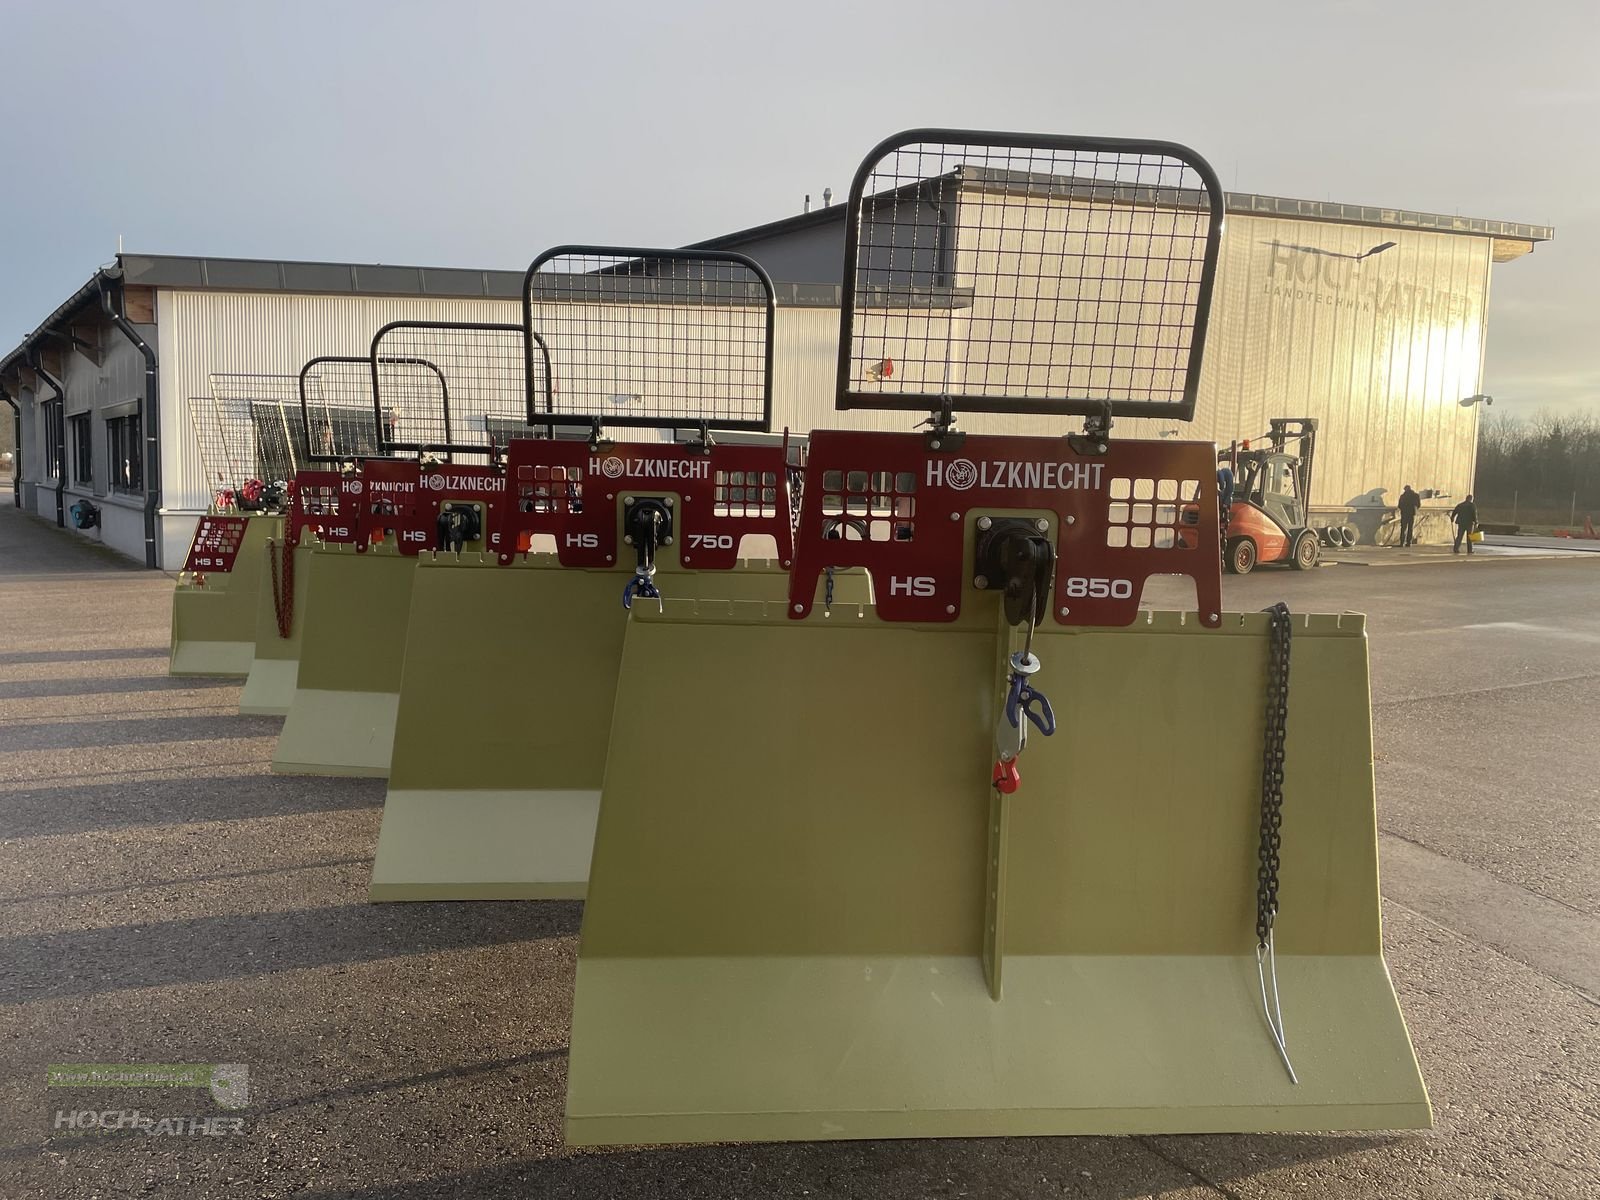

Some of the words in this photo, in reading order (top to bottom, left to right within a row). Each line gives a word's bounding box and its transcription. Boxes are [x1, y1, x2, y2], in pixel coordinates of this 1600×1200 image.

[1263, 284, 1370, 312] LANDTECHNIK
[589, 456, 711, 480] HOLZKNECHT
[926, 458, 1105, 491] HOLZKNECHT
[419, 474, 506, 492] HOLZKNECHT
[329, 527, 349, 537] HS
[403, 530, 427, 542] HS
[566, 533, 599, 548] HS
[687, 534, 733, 549] 750
[195, 558, 211, 566] HS
[889, 575, 936, 597] HS
[1066, 577, 1133, 599] 850
